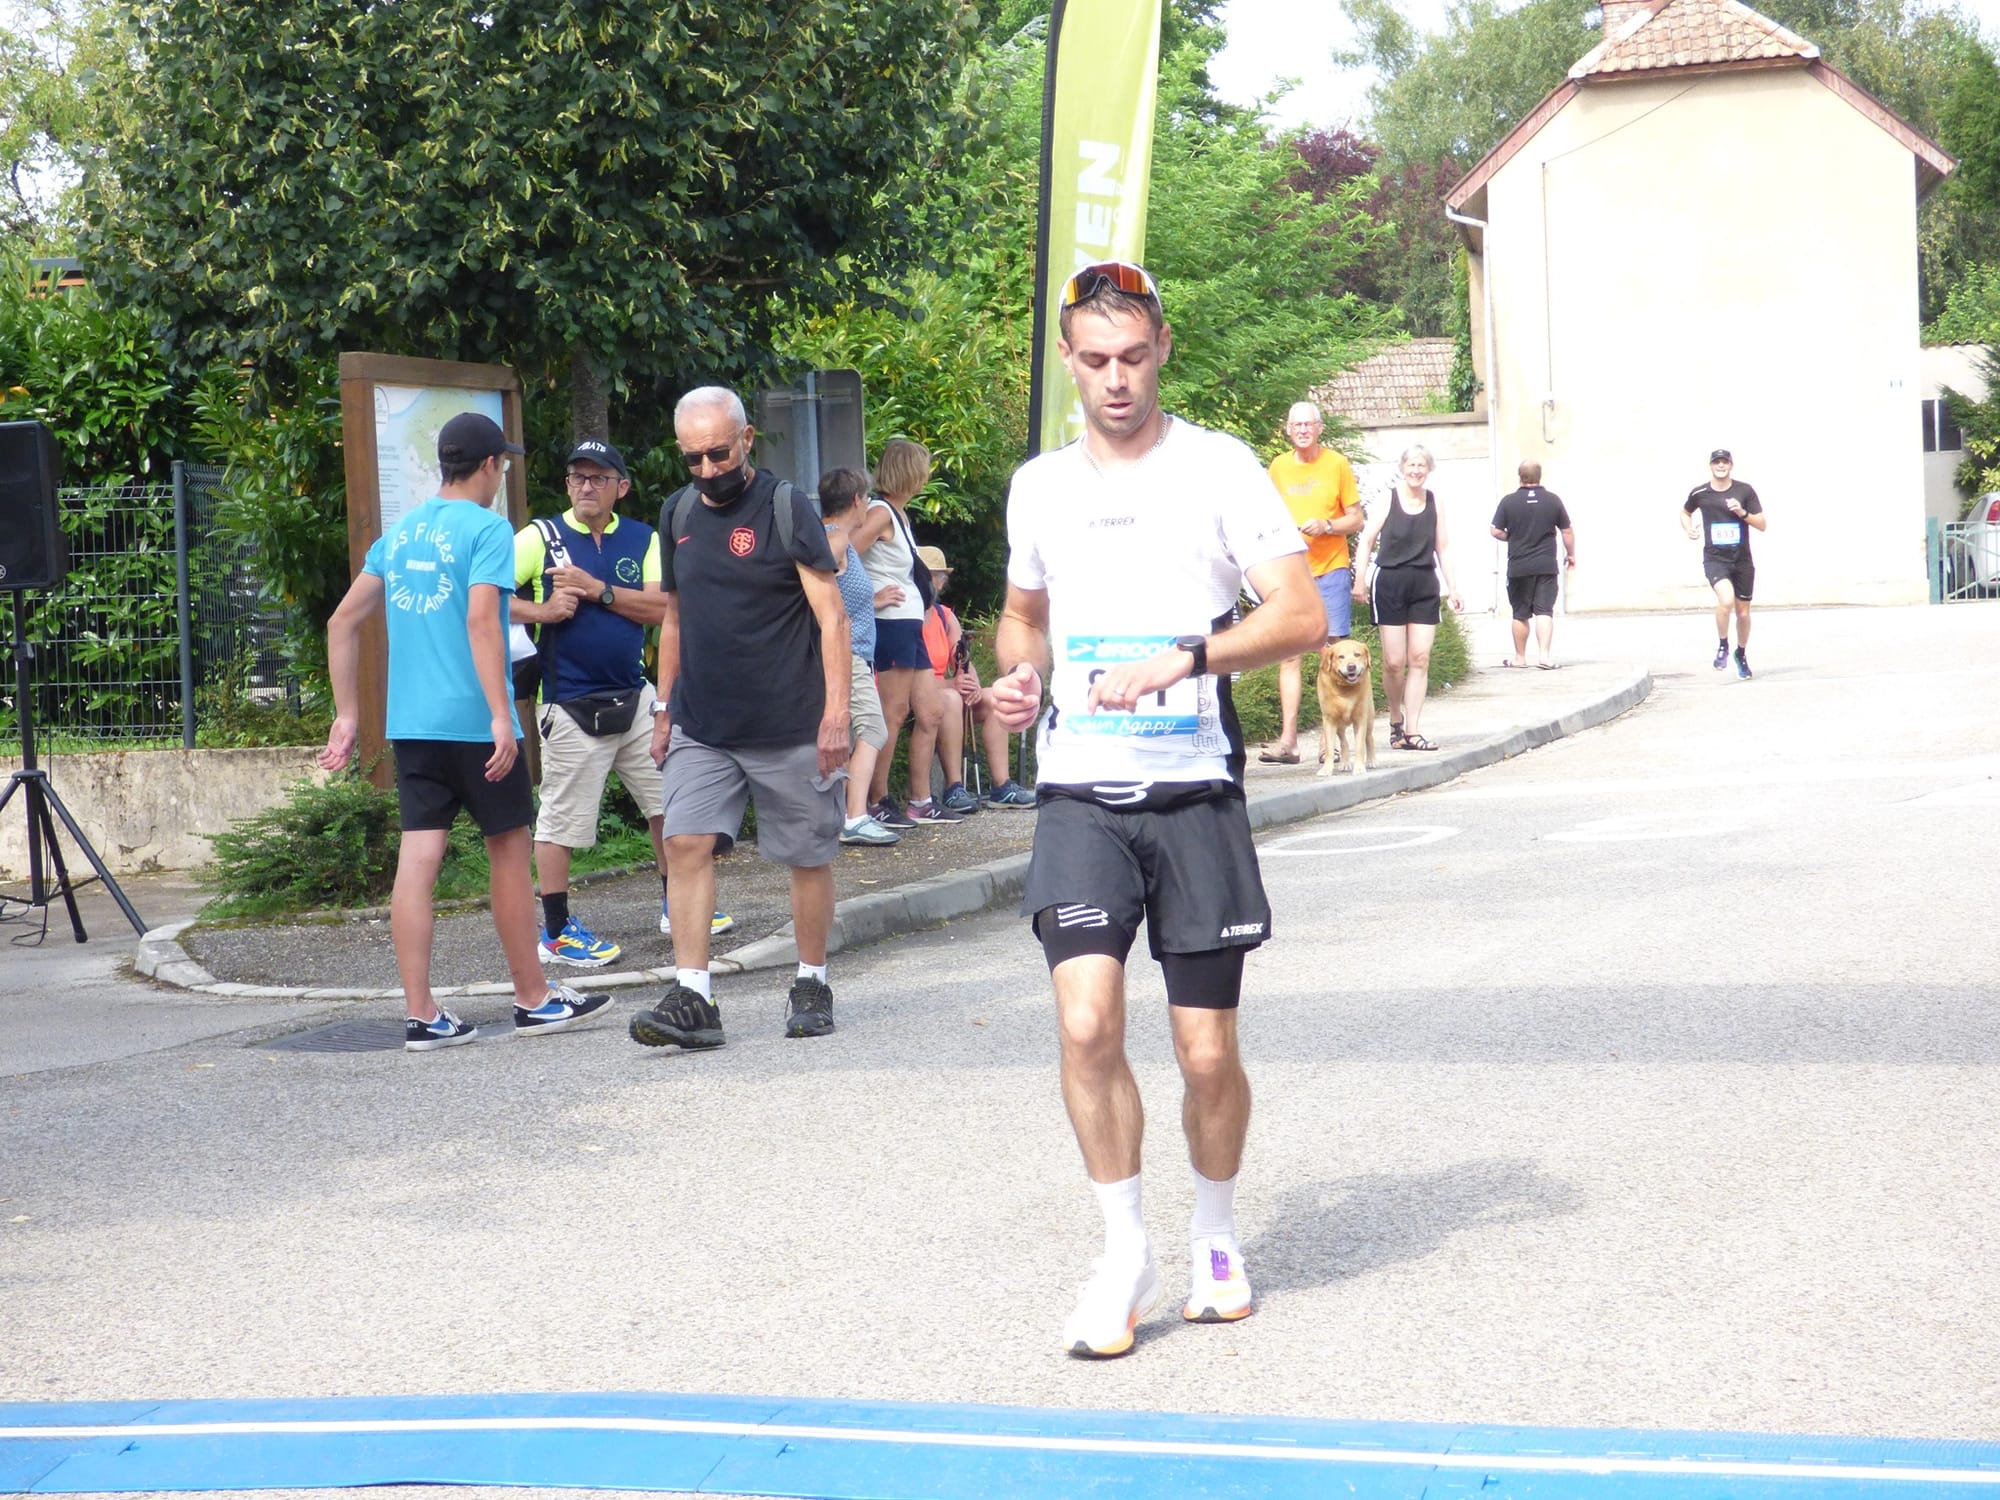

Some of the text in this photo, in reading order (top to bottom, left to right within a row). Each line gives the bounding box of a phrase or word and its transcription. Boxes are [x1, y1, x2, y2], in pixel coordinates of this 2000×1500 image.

[390, 585, 416, 611] Val
[1117, 715, 1177, 735] happy
[1230, 922, 1264, 937] TERREX
